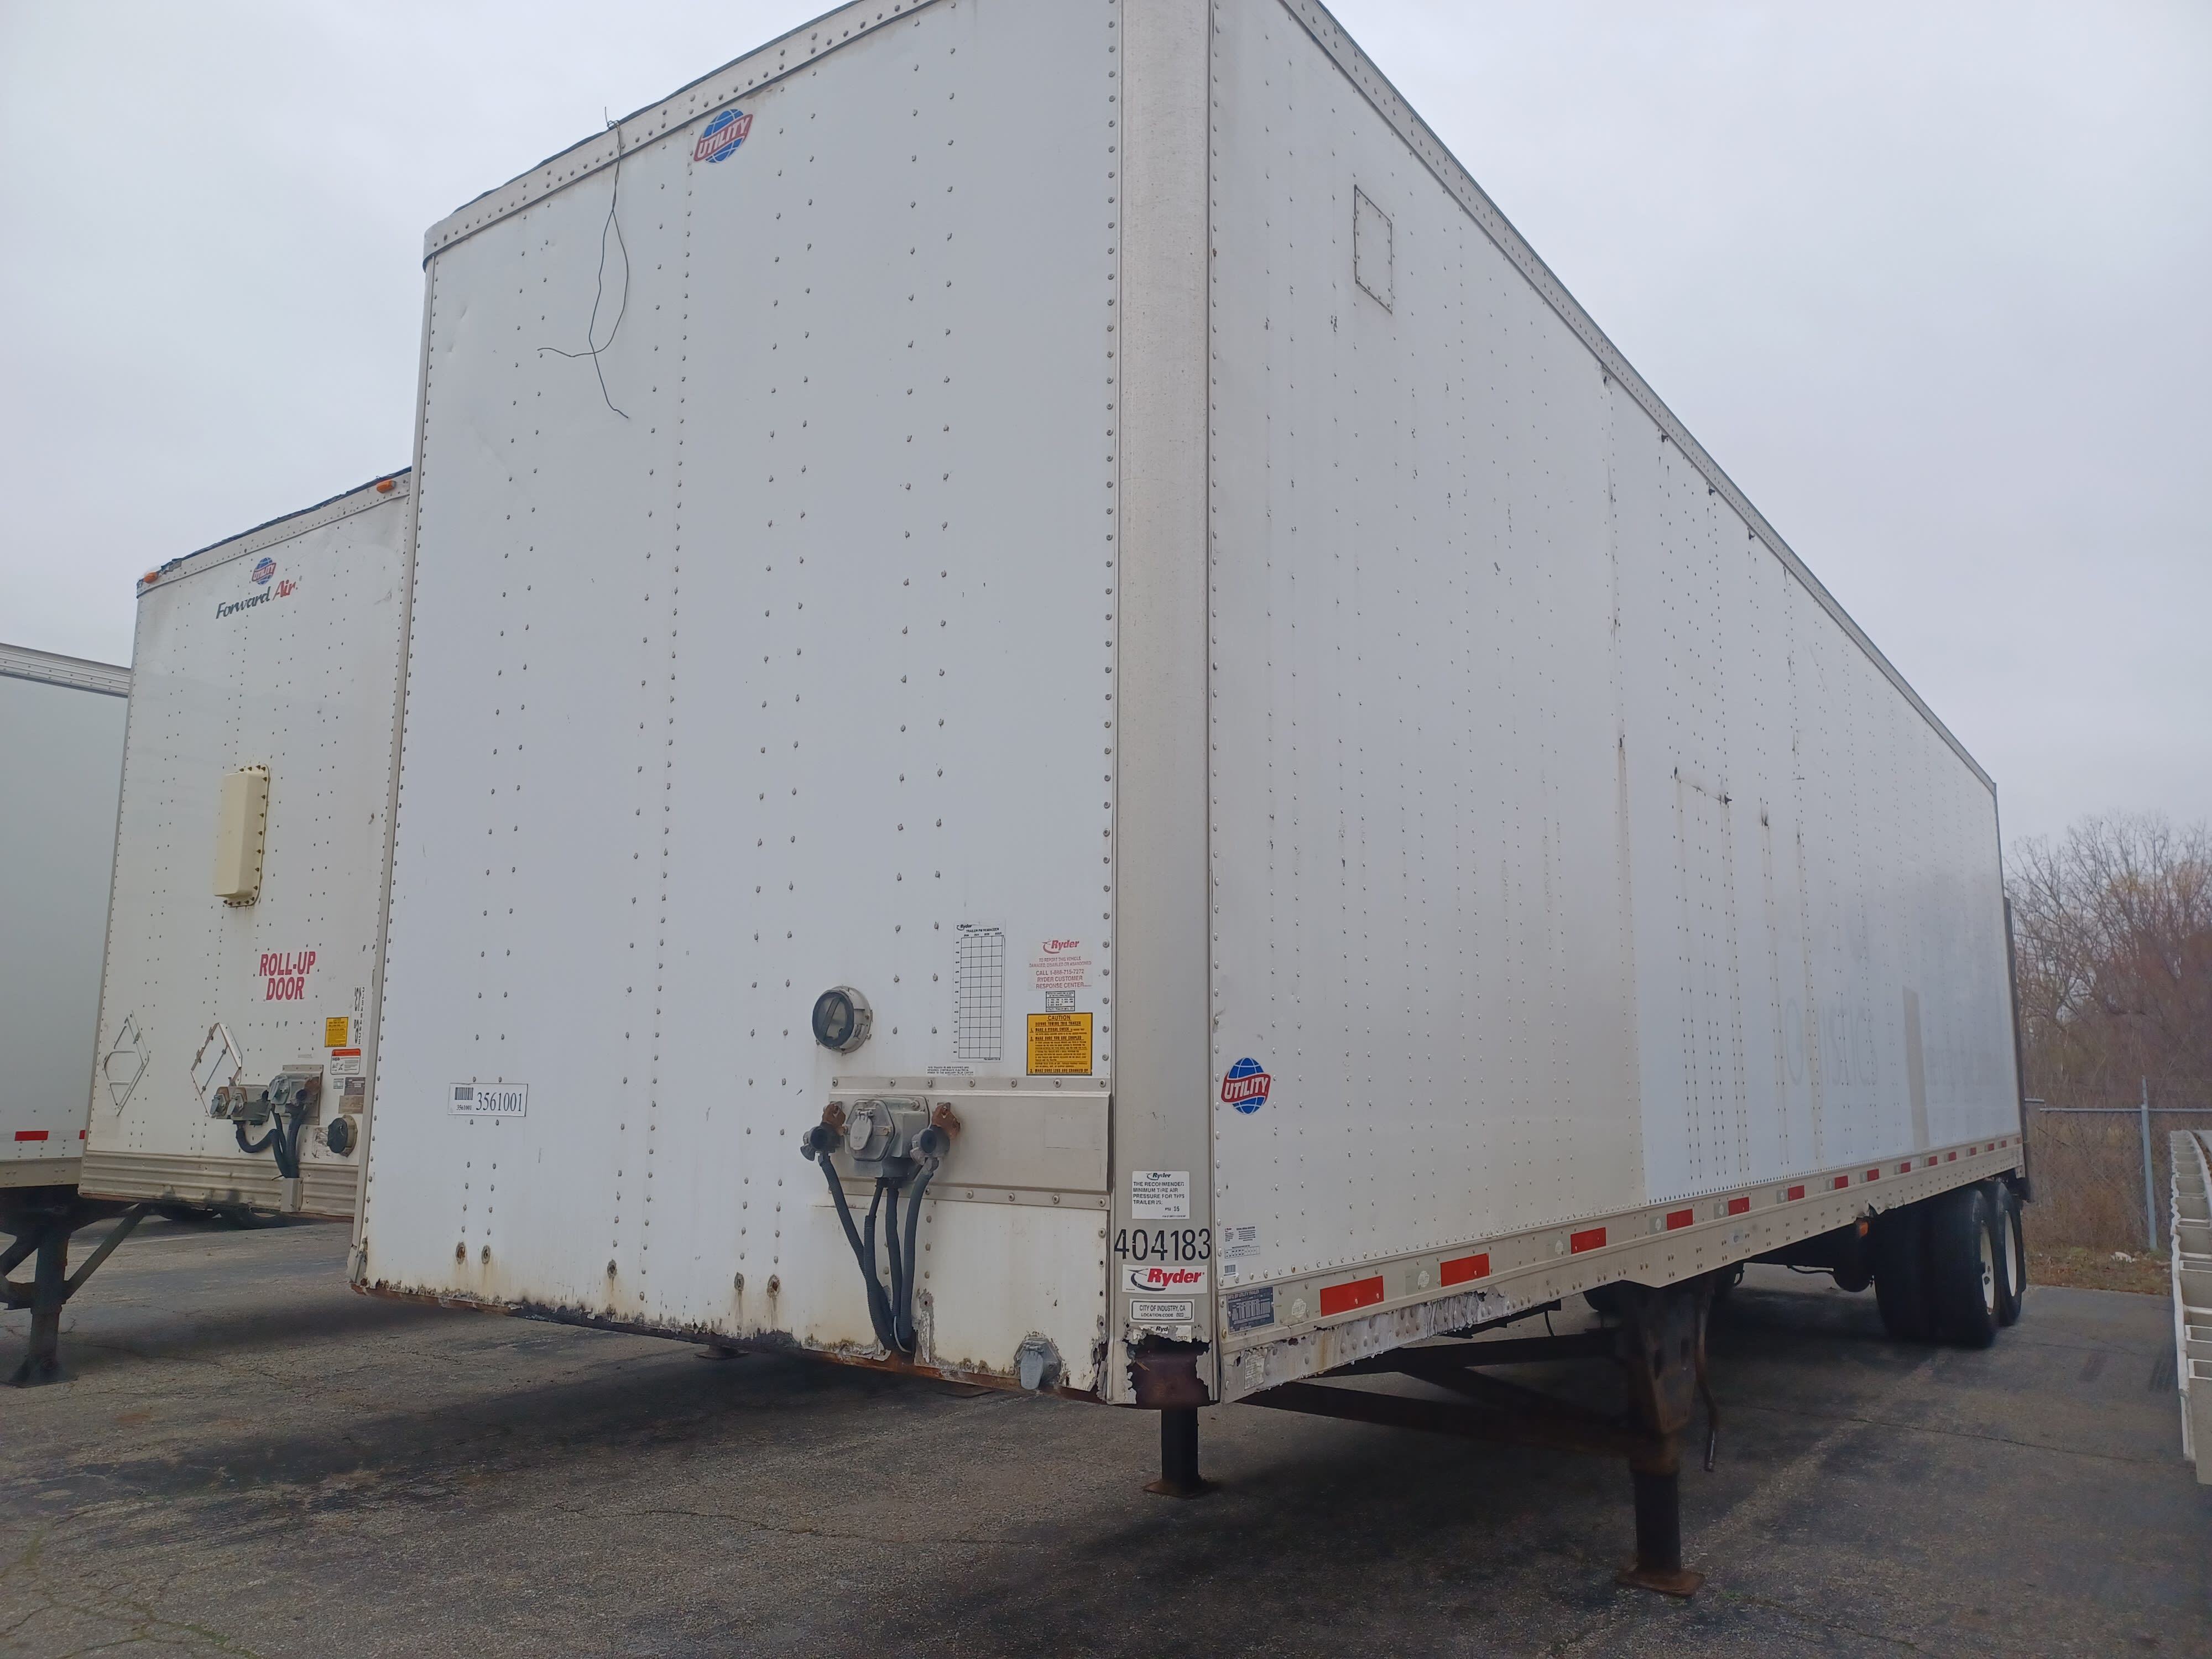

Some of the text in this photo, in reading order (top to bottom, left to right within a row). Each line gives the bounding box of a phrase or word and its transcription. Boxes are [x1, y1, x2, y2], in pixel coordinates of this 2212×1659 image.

[697, 116, 750, 158] UTILITY
[253, 564, 275, 580] UTILITY
[216, 580, 296, 619] Forward Air
[1051, 940, 1079, 951] Ryder
[259, 952, 316, 976] ROLL-UP
[266, 977, 305, 1000] DOOR
[1224, 1077, 1269, 1099] UTILITY
[476, 1092, 521, 1112] 3561001
[1114, 1228, 1211, 1261] 404183
[1147, 1268, 1202, 1287] Ryder
